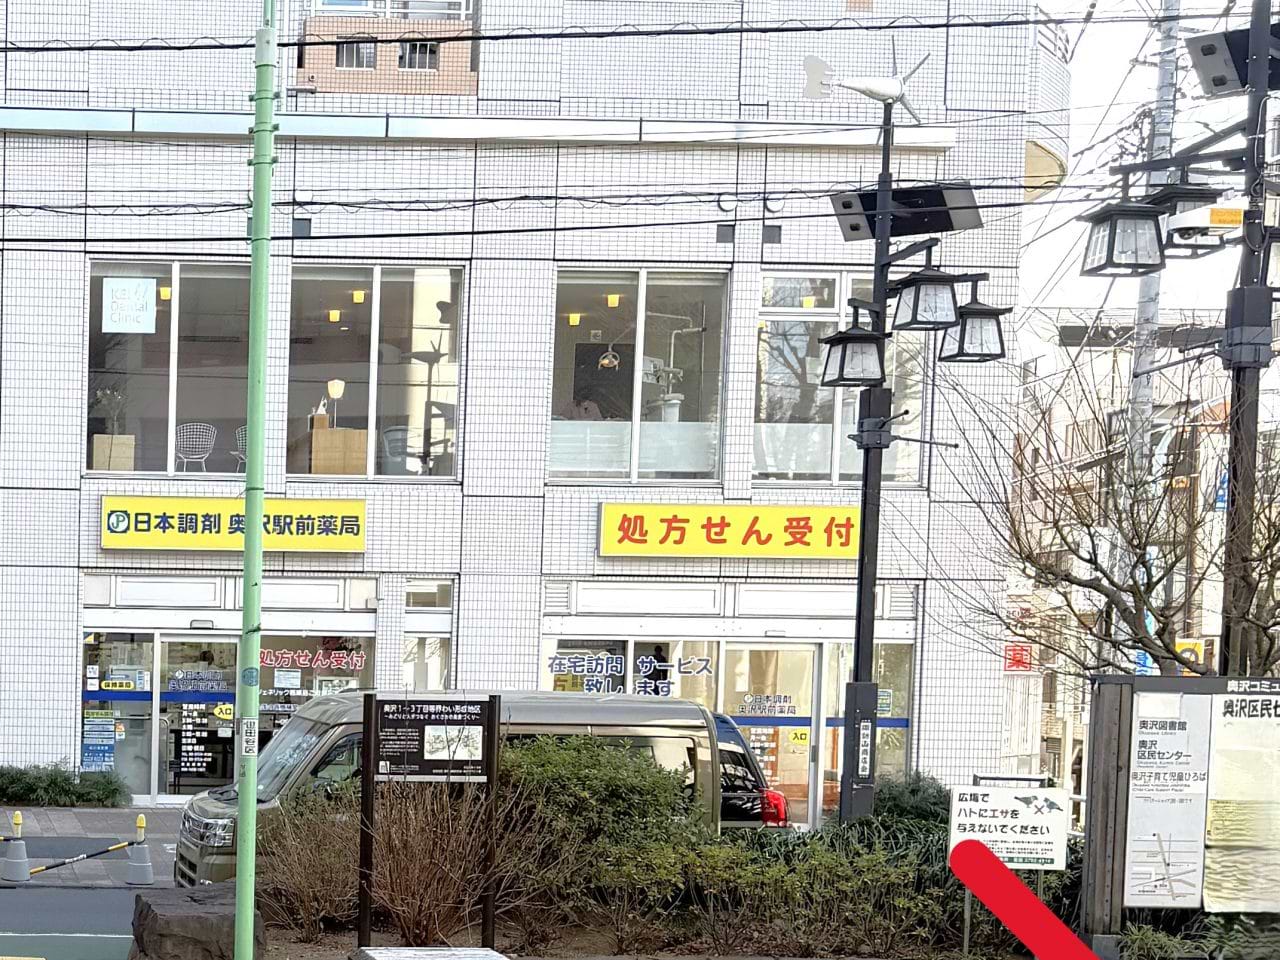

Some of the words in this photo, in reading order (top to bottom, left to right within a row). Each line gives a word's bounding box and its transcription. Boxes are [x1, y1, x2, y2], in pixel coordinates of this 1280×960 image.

[133, 512, 221, 534] 日本調剤
[617, 513, 855, 547] 処方せん受付
[260, 649, 366, 669] 処方せん受付
[548, 655, 624, 675] 在宅訪問
[638, 656, 713, 675] サービス
[1139, 720, 1187, 731] 奥沢図書館
[793, 733, 807, 741] 入口
[1138, 740, 1158, 749] 奥沢
[1137, 750, 1192, 760] 区民センター
[958, 793, 990, 803] 広場で
[958, 808, 1019, 819] ハトにエサを
[957, 823, 1050, 835] 与えないでください
